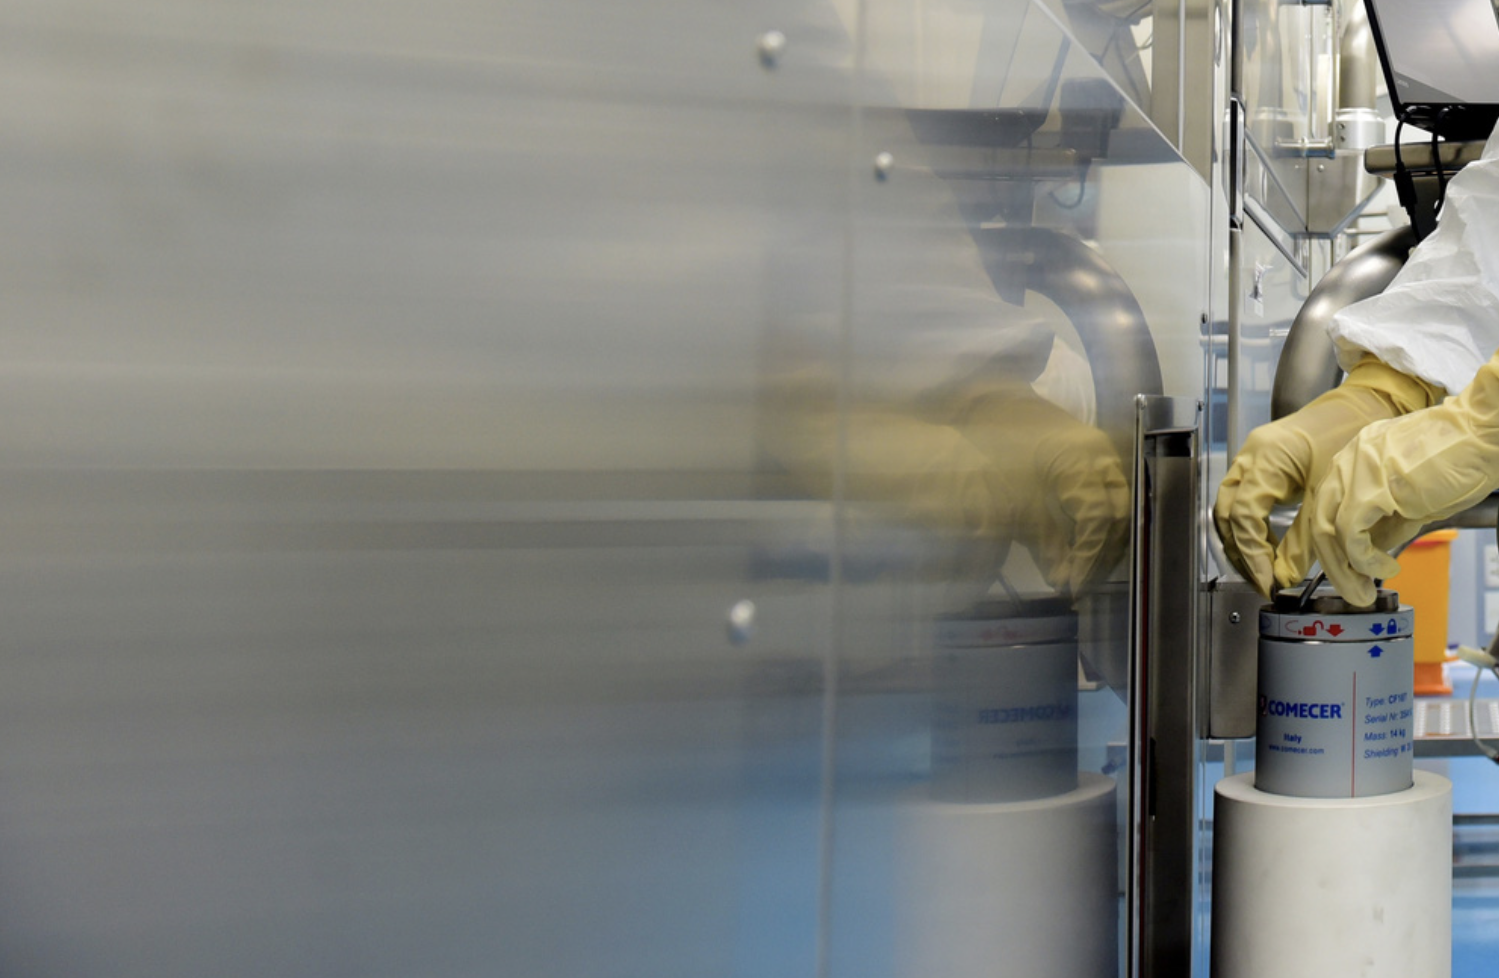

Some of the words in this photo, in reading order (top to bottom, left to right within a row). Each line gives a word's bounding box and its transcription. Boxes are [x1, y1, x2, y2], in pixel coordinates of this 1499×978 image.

[1268, 700, 1342, 719] COMECER
[1365, 713, 1388, 724] Serial
[1283, 733, 1302, 744] Italy
